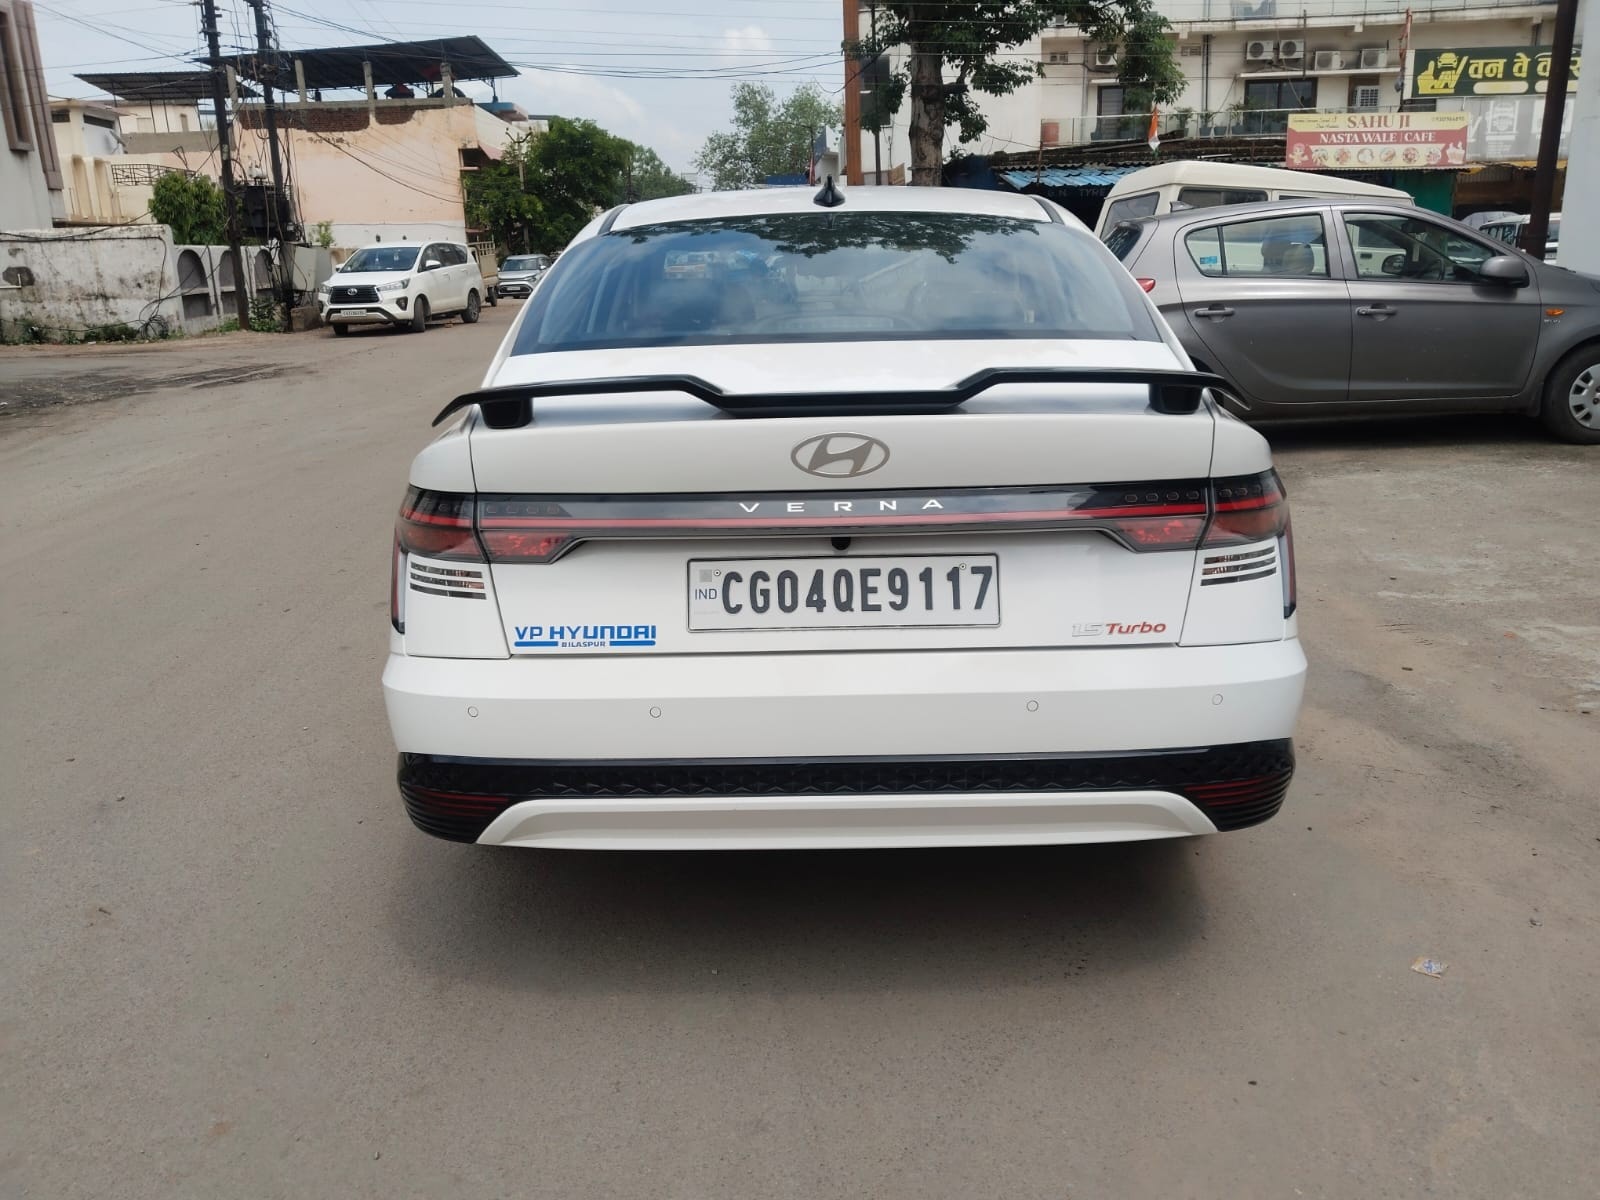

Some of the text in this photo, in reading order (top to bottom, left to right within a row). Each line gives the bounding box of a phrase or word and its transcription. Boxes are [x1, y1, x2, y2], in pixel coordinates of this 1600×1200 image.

[1468, 57, 1507, 79] वन
[1512, 52, 1531, 78] वे
[1347, 115, 1393, 129] SAHU
[1399, 115, 1411, 130] JI
[1319, 131, 1436, 144] NASTA WALE CAFE
[738, 499, 946, 513] VERNA
[694, 566, 993, 614] IND CG04QE9117
[515, 625, 657, 640] VP HYUNDAI
[1106, 621, 1167, 635] Turbo
[561, 640, 606, 648] BILASPUR
